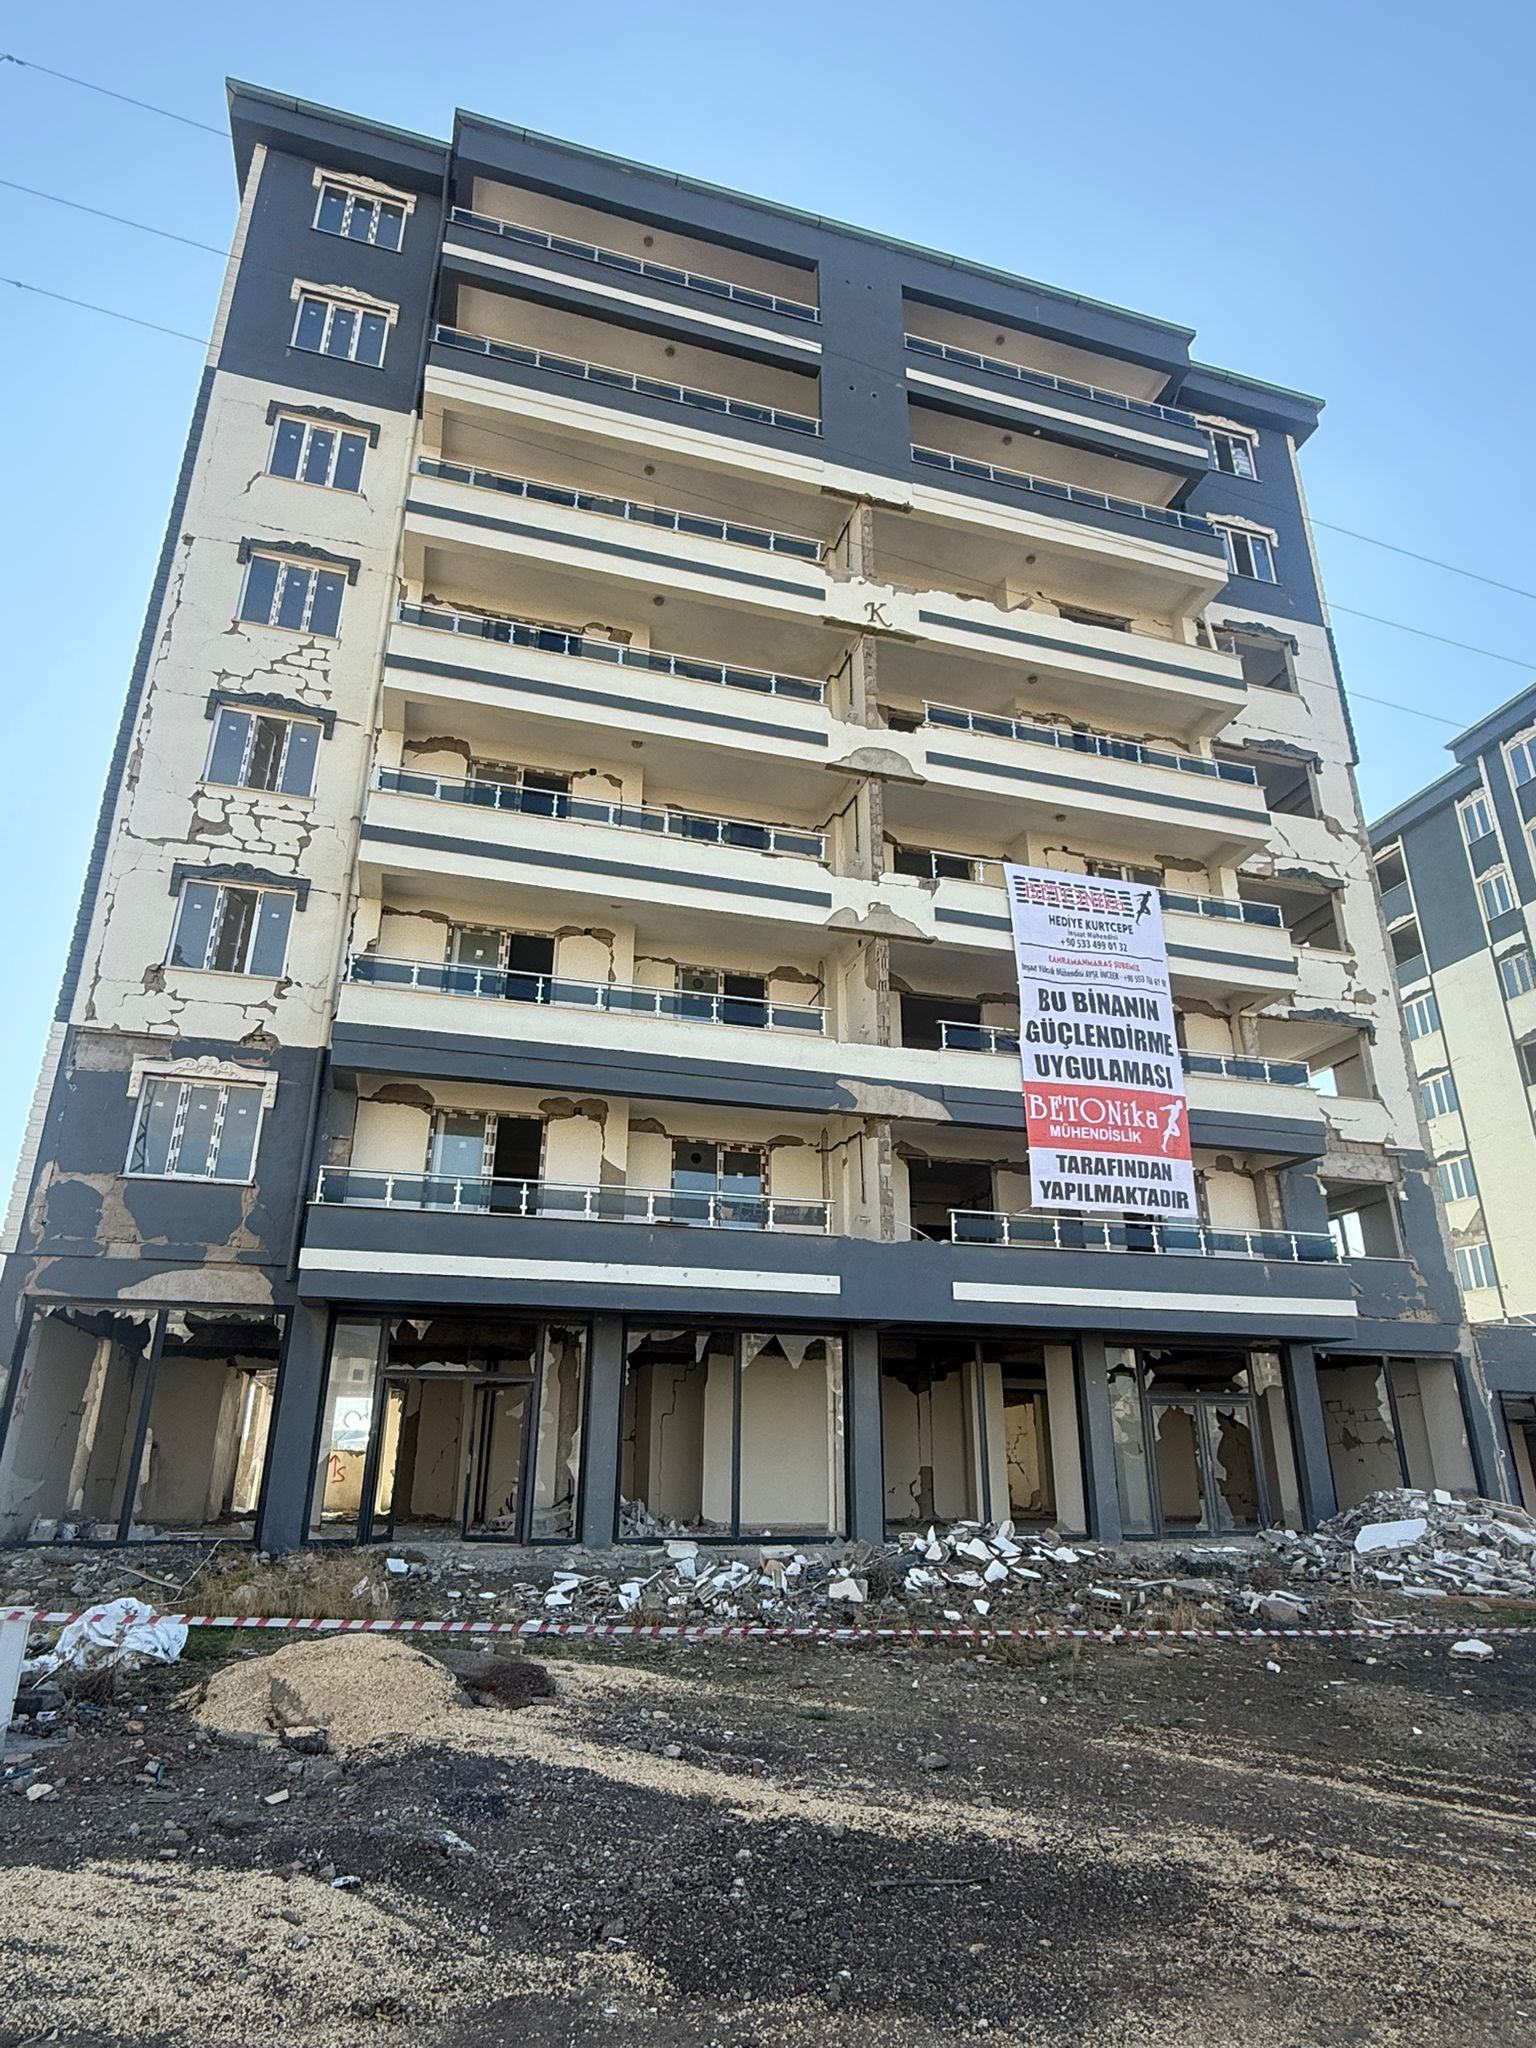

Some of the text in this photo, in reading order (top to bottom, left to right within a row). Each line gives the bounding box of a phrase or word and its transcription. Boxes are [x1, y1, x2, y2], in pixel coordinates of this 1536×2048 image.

[864, 602, 893, 627] K
[1048, 914, 1134, 935] HEDİYE KURTCEPE
[1060, 937, 1075, 947] +90
[1077, 939, 1091, 948] 533
[1093, 940, 1106, 950] 499
[1119, 942, 1128, 952] 32
[1038, 988, 1160, 1021] BU BİNANIN
[1026, 1018, 1174, 1057] GÜÇLENDİRME
[1034, 1054, 1173, 1089] UYGULAMASI
[1050, 1123, 1142, 1143] MÜHENDİSLİK
[1056, 1154, 1173, 1181] TARAFINDAN
[1039, 1180, 1189, 1209] YAPILMAKTADIR
